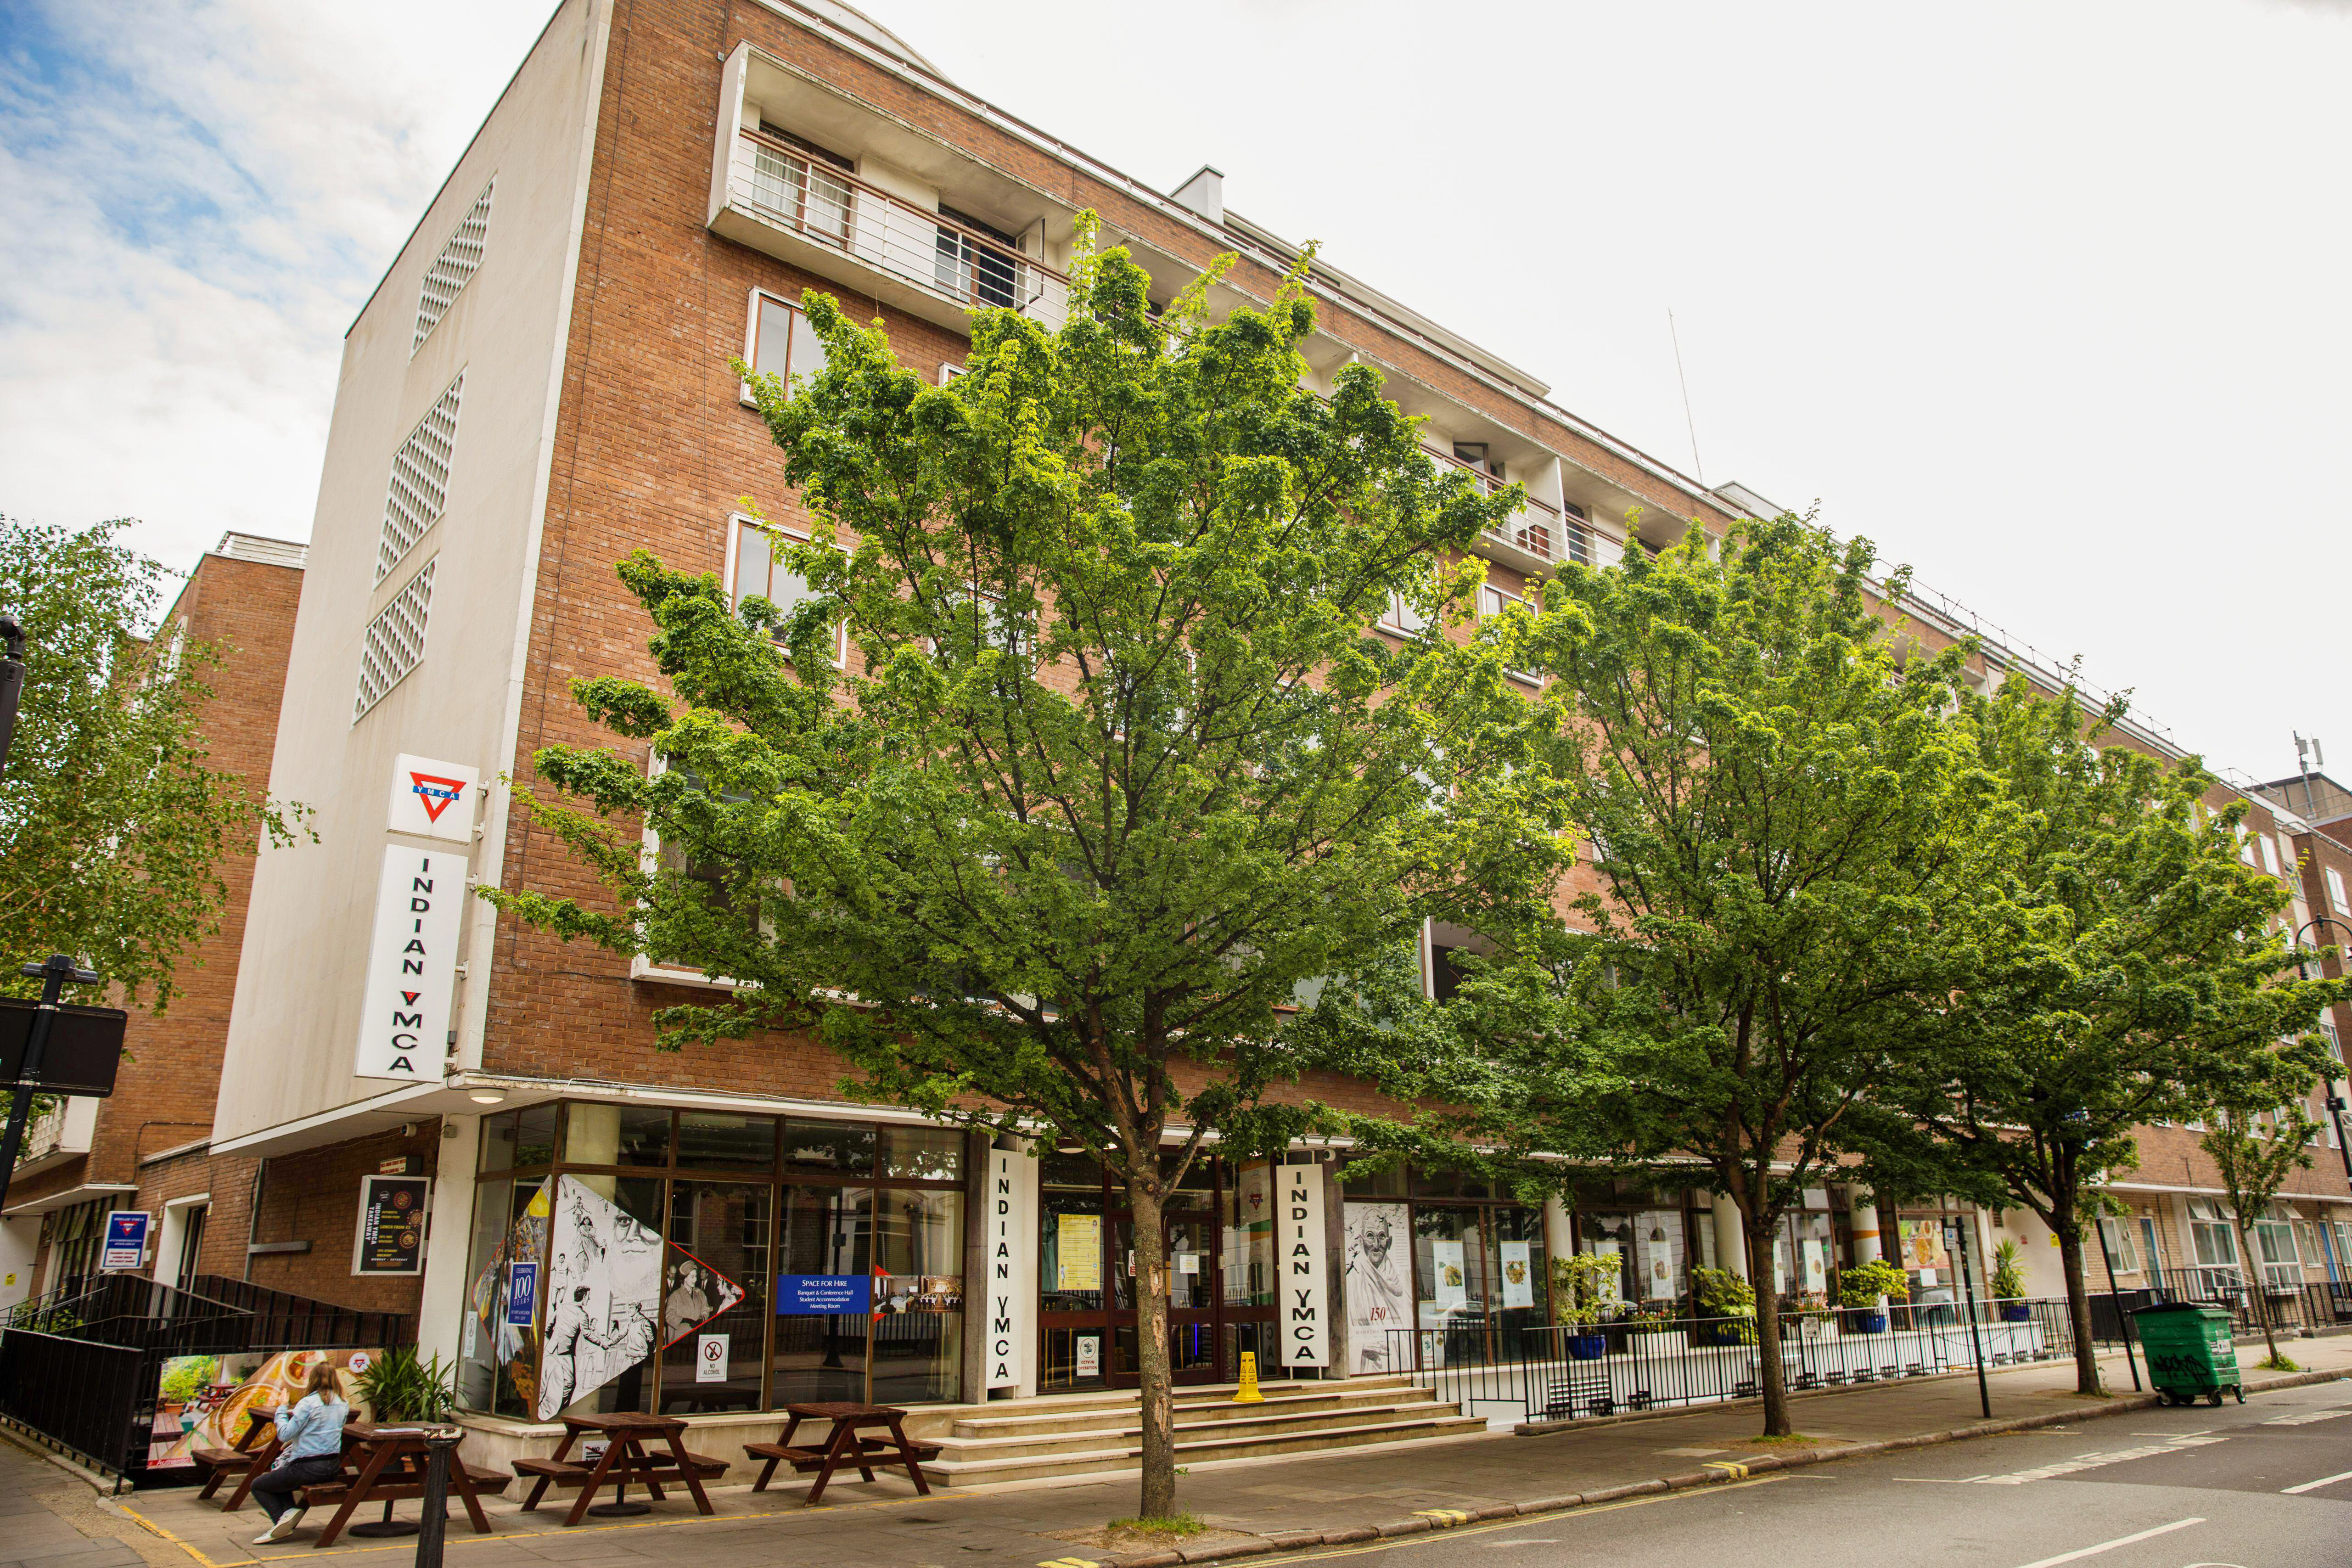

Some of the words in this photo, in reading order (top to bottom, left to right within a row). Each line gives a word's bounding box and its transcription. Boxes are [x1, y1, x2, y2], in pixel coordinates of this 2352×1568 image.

[417, 787, 455, 799] YMCA
[403, 858, 433, 976] INDIAN
[388, 990, 423, 1073] YMCA
[365, 1206, 375, 1241] TAKEAWAY
[370, 1226, 379, 1245] YMCA
[373, 1203, 382, 1225] INDIAN
[997, 1158, 1009, 1278] INDIAN
[1291, 1172, 1310, 1275] INDIAN
[514, 1275, 531, 1300] 100
[995, 1296, 1010, 1378] YMCA
[1292, 1289, 1315, 1359] YMCA
[1370, 1307, 1386, 1321] 150
